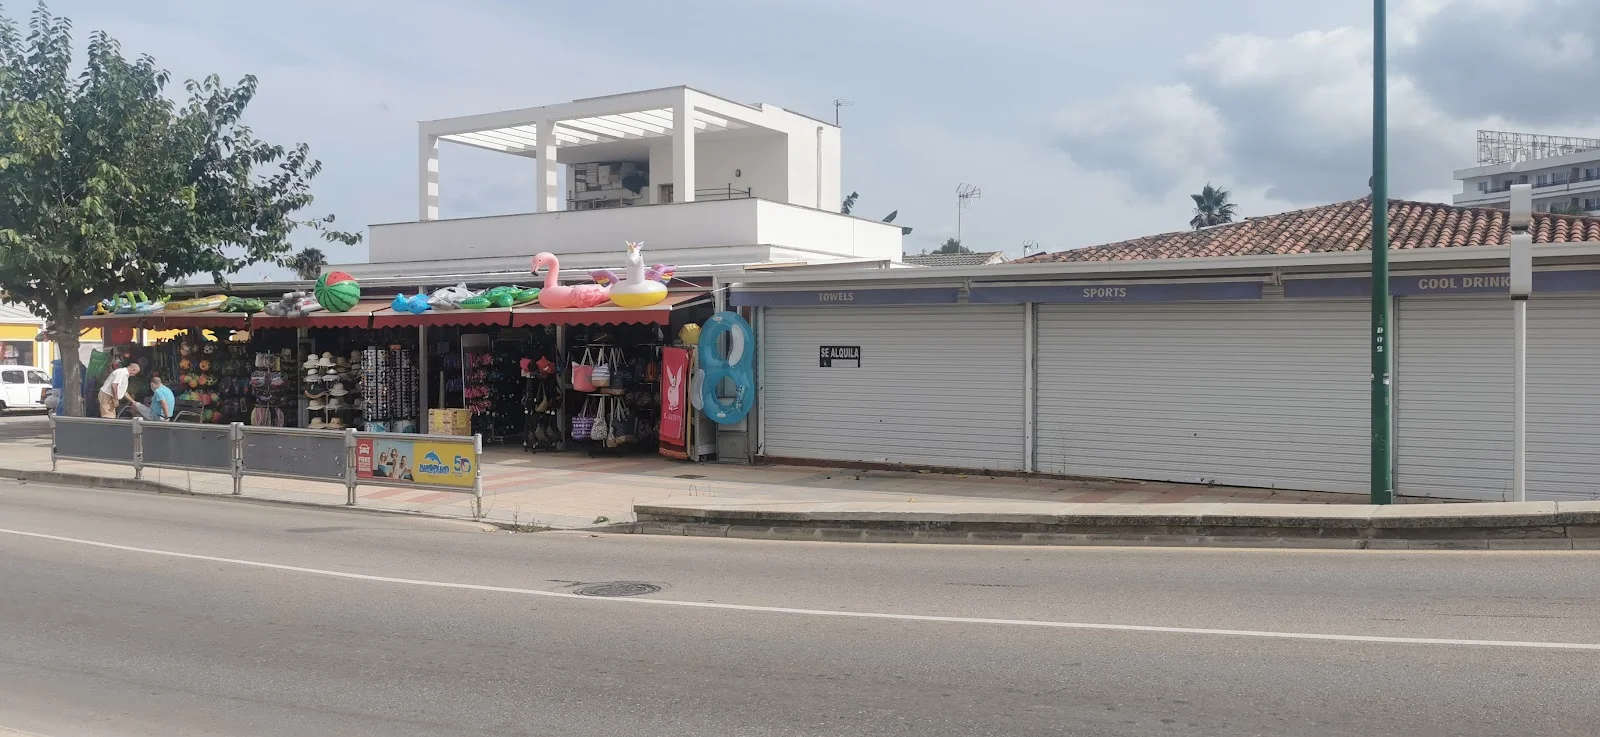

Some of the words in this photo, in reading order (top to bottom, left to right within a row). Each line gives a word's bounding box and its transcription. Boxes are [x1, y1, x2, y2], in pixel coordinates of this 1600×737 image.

[1418, 278, 1457, 290] COOL
[819, 292, 854, 301] TOWELS
[1083, 287, 1126, 297] SPORTS
[820, 347, 829, 358] SE
[831, 347, 859, 358] ALQUILA
